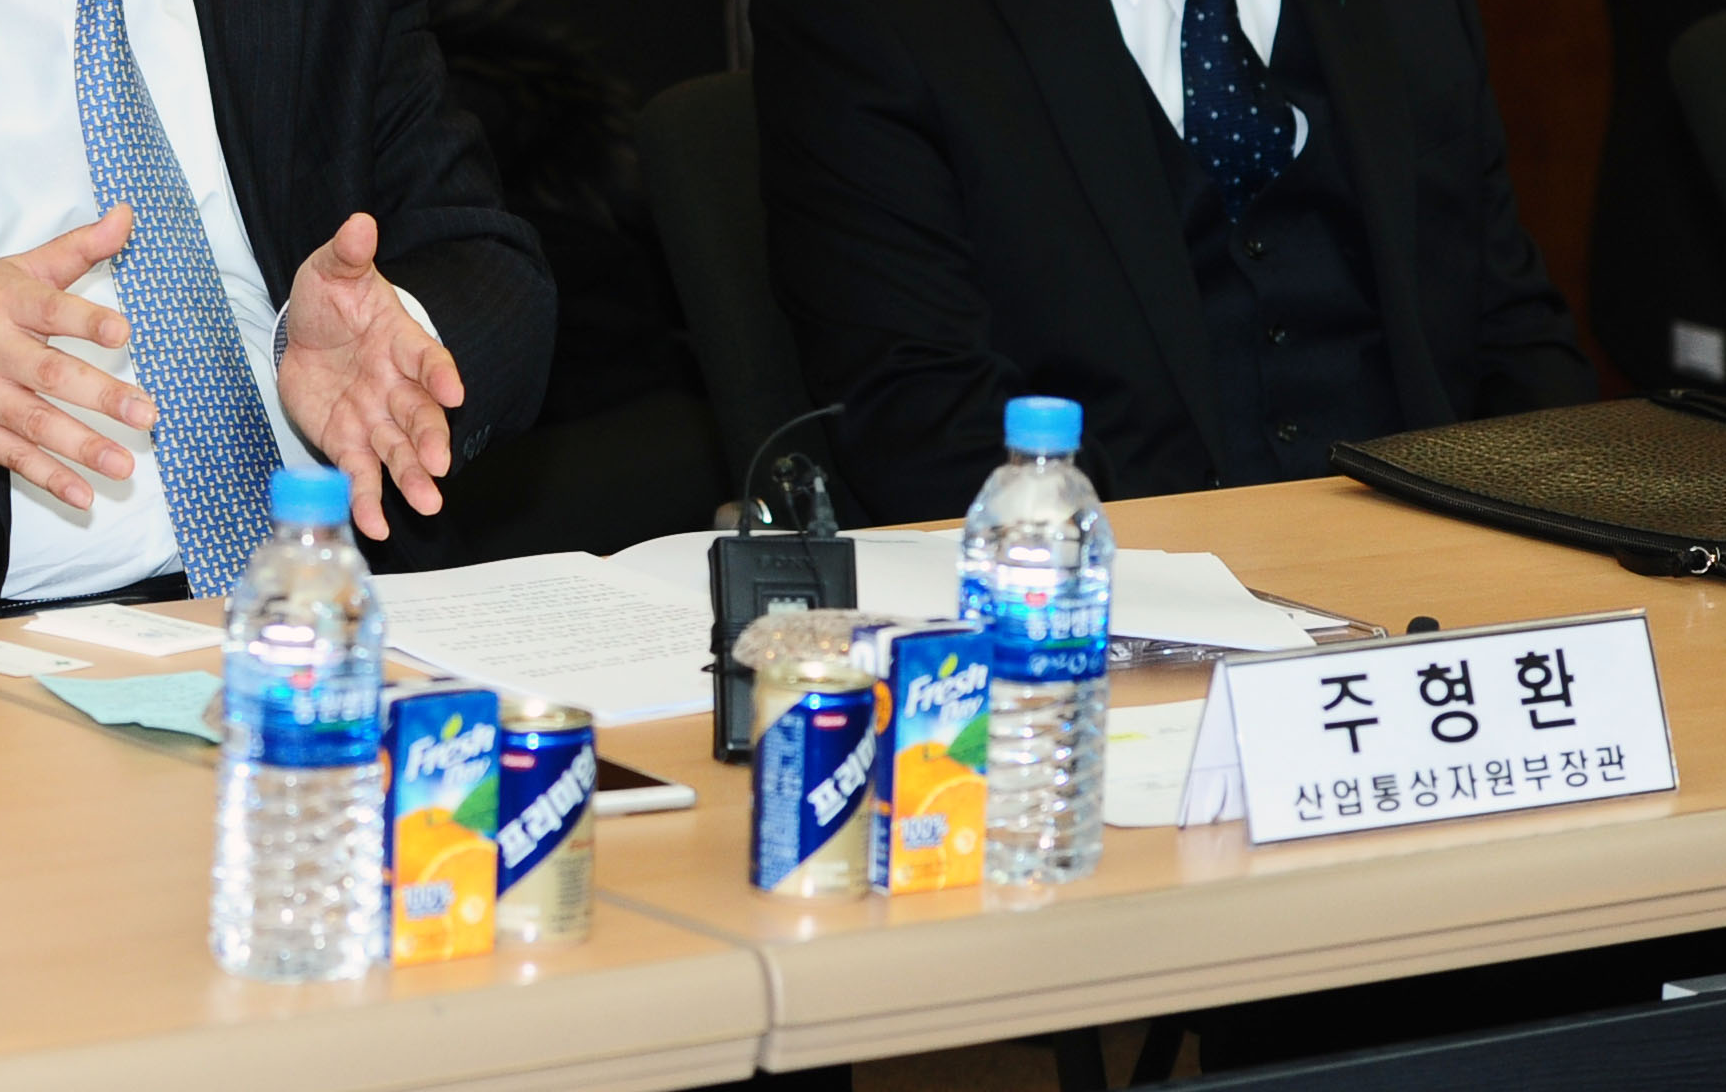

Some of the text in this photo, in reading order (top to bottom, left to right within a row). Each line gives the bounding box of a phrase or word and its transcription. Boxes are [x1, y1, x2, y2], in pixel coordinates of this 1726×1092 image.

[904, 662, 988, 719] Fresh
[404, 722, 496, 783] Fresh
[1293, 745, 1627, 823] 산업통상자원부장관
